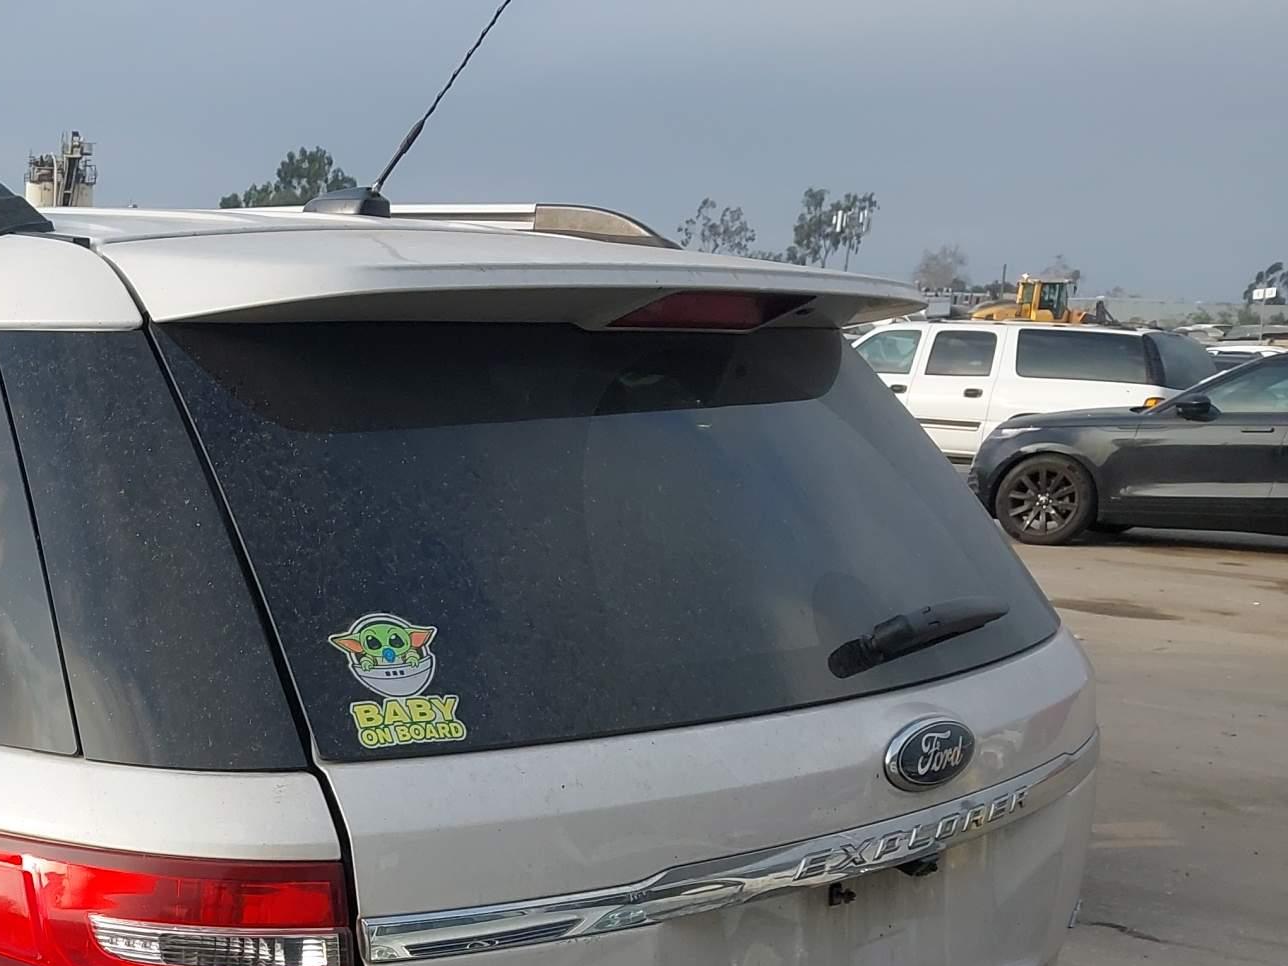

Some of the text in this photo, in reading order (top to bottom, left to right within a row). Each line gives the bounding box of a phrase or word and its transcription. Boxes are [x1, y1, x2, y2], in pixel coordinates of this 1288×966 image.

[353, 697, 458, 728] BABY
[360, 722, 464, 746] ON BOARD
[916, 729, 965, 776] Ford
[792, 785, 1030, 882] EXPLORER
